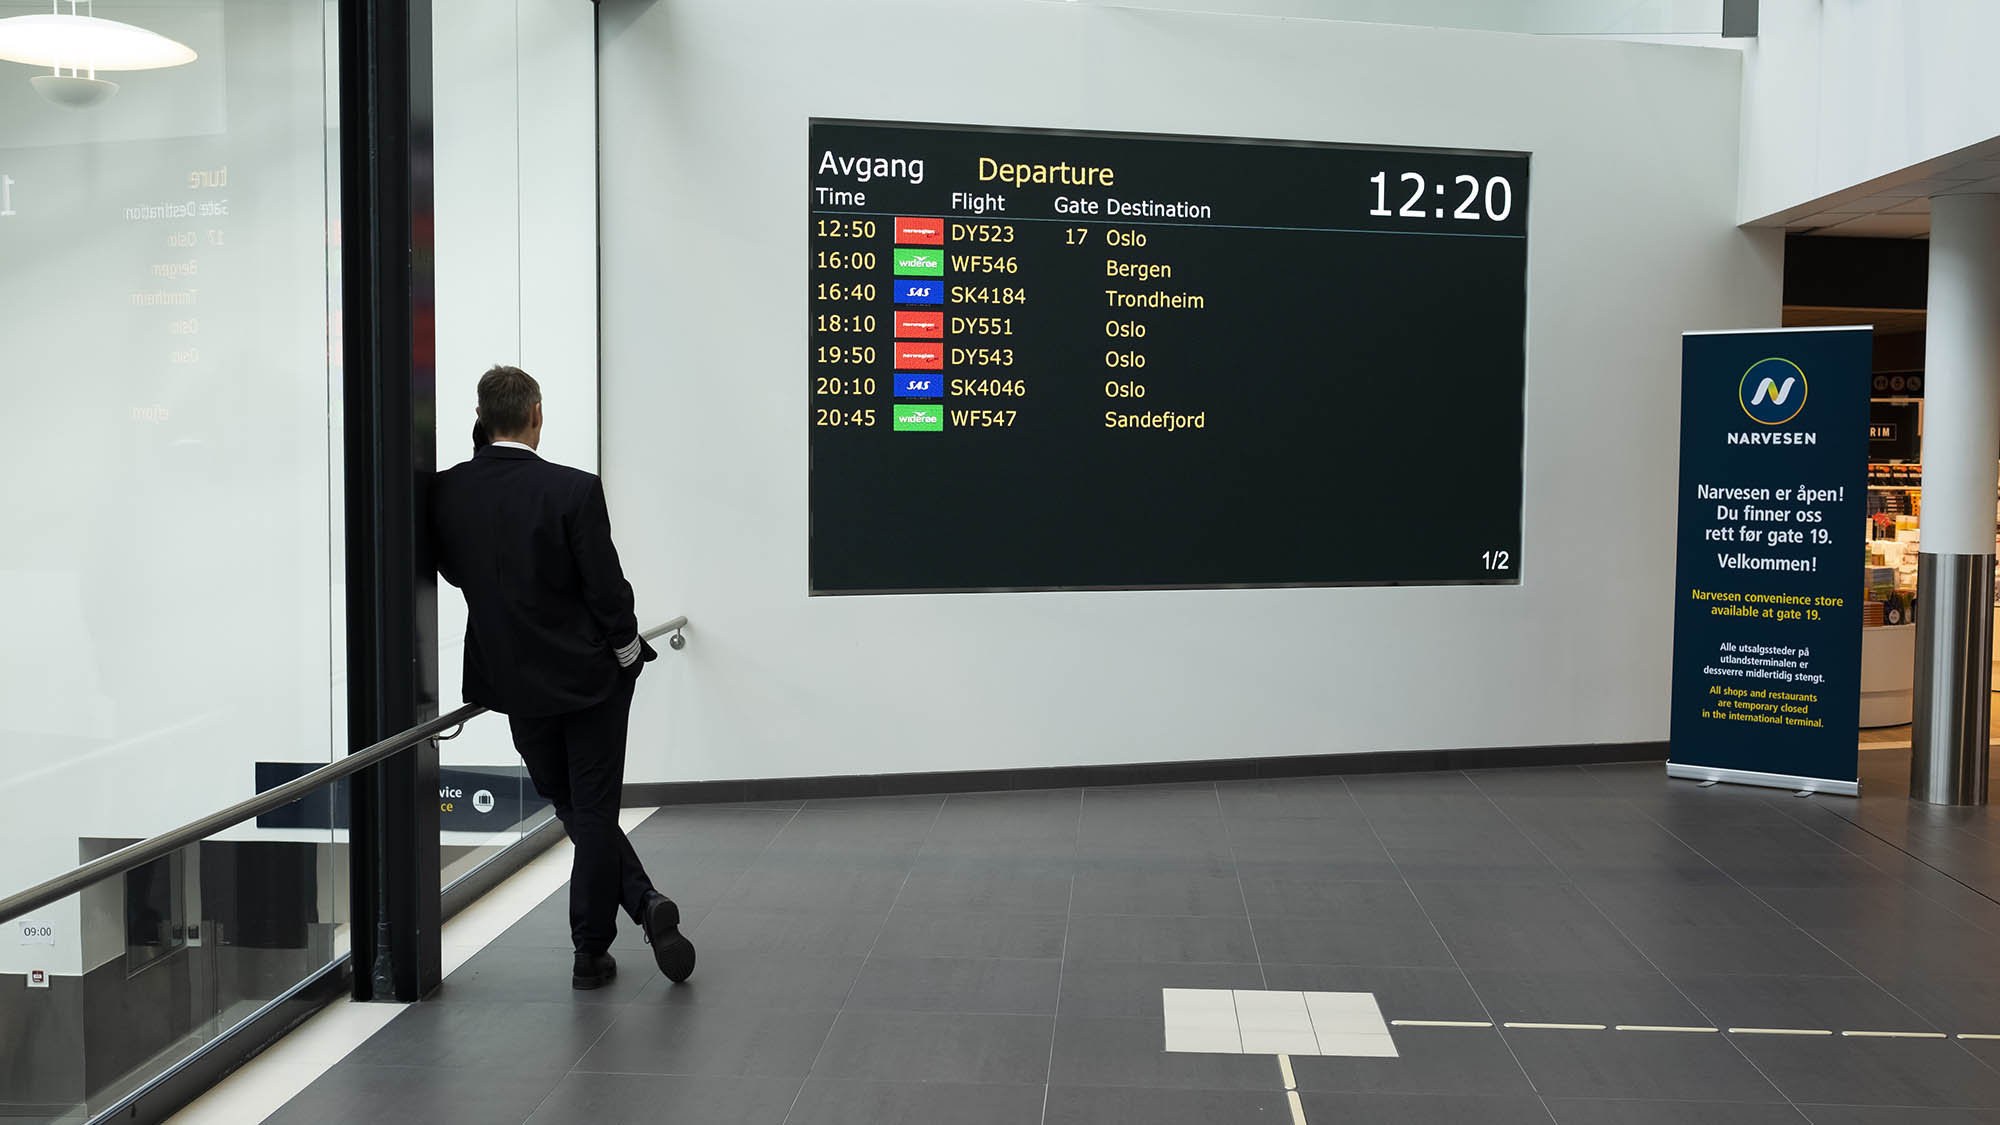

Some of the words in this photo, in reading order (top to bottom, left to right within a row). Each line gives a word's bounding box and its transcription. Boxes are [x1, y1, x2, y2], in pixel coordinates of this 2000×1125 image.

[819, 151, 924, 183] Avgang
[979, 158, 1114, 187] Departure
[816, 187, 866, 206] Time
[952, 192, 1006, 213] Flight
[1055, 197, 1099, 215] Gate
[1107, 199, 1211, 219] Destination
[1369, 171, 1512, 222] 12:20
[818, 221, 876, 239] 12:50
[952, 226, 1014, 243] DY523
[1065, 228, 1088, 245] 17
[1106, 230, 1147, 247] Oslo
[818, 252, 876, 270] 16:00
[951, 256, 1018, 274] WF546
[1106, 259, 1172, 281] Bergen
[818, 284, 876, 302] 16:40
[907, 288, 931, 297] SAS
[951, 287, 1026, 305] SK4184
[1106, 290, 1204, 309] Trondheim
[818, 315, 876, 333] 18:10
[951, 318, 1013, 335] DY551
[1106, 320, 1146, 338] Oslo
[818, 346, 876, 364] 19:50
[951, 349, 1014, 366] DY543
[1105, 351, 1146, 368] Oslo
[816, 377, 876, 395] 20:10
[906, 381, 931, 390] SAS
[950, 379, 1026, 397] SK4046
[1105, 381, 1146, 398] Oslo
[816, 408, 876, 427] 20:45
[950, 410, 1017, 427] WF547
[1105, 410, 1205, 432] Sandefjord
[1727, 432, 1817, 445] NARVESEN
[1697, 484, 1770, 500] Narvesen
[1775, 488, 1792, 501] er
[1796, 484, 1844, 505] åpen!
[1717, 505, 1739, 521] Du
[1743, 505, 1791, 522] finner
[1796, 510, 1822, 523] oss
[1705, 526, 1735, 541] rett
[1739, 525, 1763, 542] før
[1767, 529, 1804, 547] gate
[1810, 528, 1832, 544] 19.
[1482, 551, 1509, 570] 1/2
[1717, 553, 1817, 572] Velkommen!
[1692, 589, 1741, 602] Narvesen
[1744, 593, 1812, 606] convenience
[1814, 595, 1844, 607] store
[1711, 604, 1759, 617] available
[1761, 608, 1773, 618] at
[1776, 609, 1802, 621] gate
[1805, 609, 1821, 621] 19.
[1719, 642, 1737, 652] Alle
[1738, 644, 1796, 656] utsalgssteder
[1798, 647, 1810, 658] på
[1720, 654, 1797, 669] utlandsterminalen
[1799, 661, 1809, 669] er
[1703, 665, 1744, 677] dessverre
[1745, 669, 1793, 682] midlertidig
[1794, 672, 1825, 684] stengt.
[1709, 685, 1722, 695] All
[1723, 686, 1748, 698] shops
[1750, 689, 1767, 698] and
[1768, 691, 1818, 703] restaurants
[1717, 700, 1732, 708] are
[1734, 700, 1778, 714] temporary
[1780, 703, 1809, 714] closed
[1702, 708, 1710, 718] in
[1712, 709, 1727, 719] the
[1728, 711, 1783, 724] international
[1785, 716, 1824, 728] terminal.
[440, 803, 454, 812] ce
[24, 927, 52, 937] 09:00
